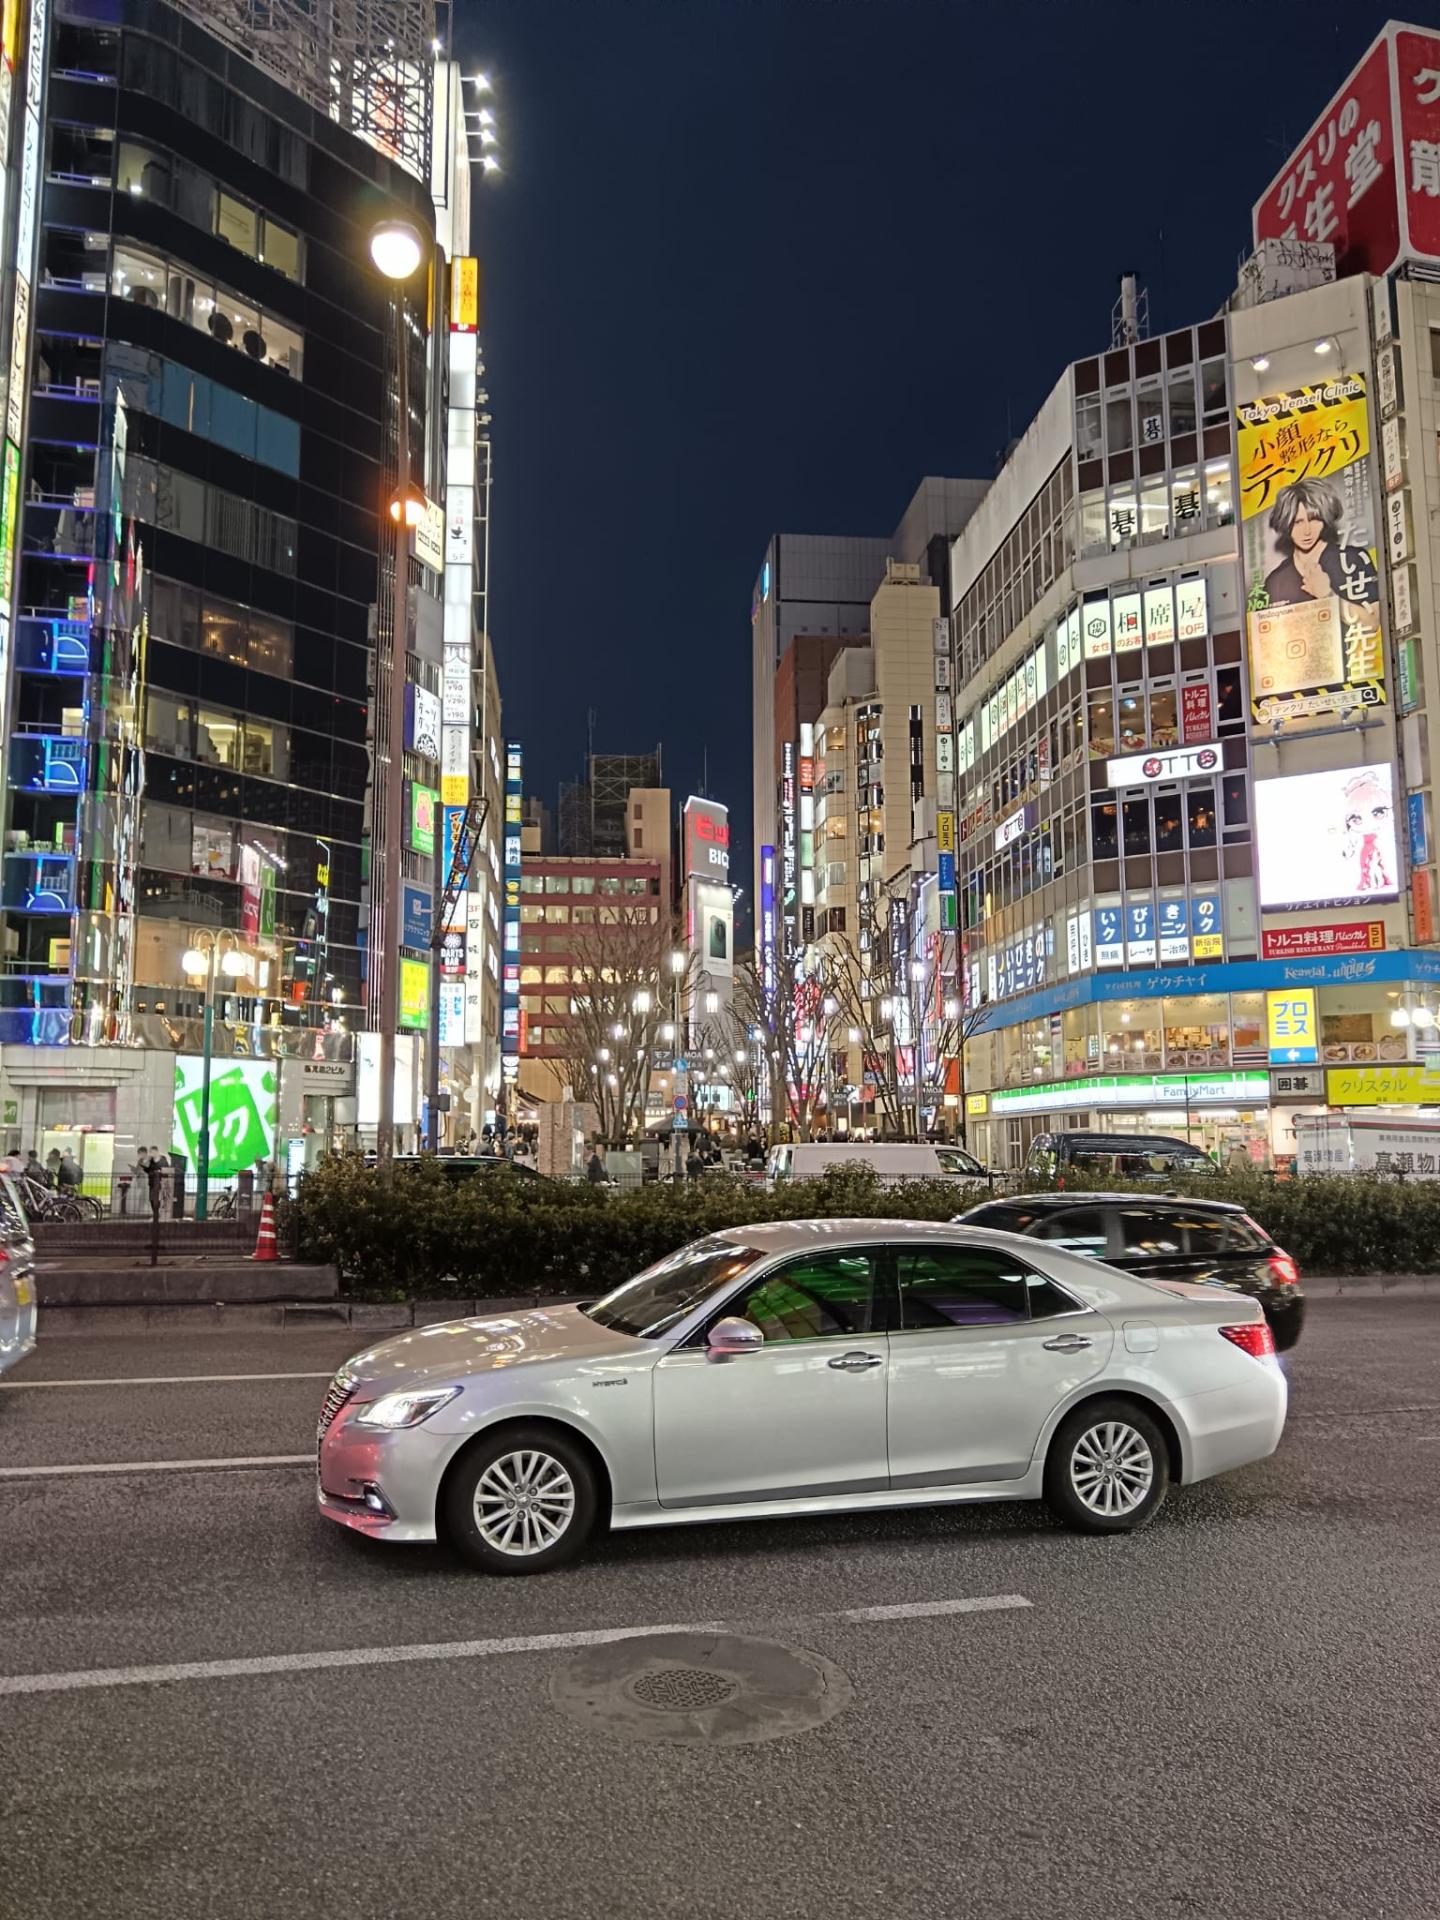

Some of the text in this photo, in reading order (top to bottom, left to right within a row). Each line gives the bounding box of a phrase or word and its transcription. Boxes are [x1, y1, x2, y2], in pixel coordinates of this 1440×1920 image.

[1277, 97, 1360, 220] クスリの
[1280, 119, 1384, 242] 生堂
[1242, 380, 1361, 421] Tokyo Tensei Clinic
[1144, 418, 1161, 440] 碁
[1173, 489, 1200, 519] 碁
[1111, 508, 1136, 535] 碁
[1117, 596, 1206, 634] 相席屋
[1184, 688, 1208, 700] トルコ
[942, 816, 950, 847] プロミス
[1266, 929, 1335, 948] トルコ料理
[441, 947, 464, 959] DARTS
[444, 957, 460, 967] BAR
[1146, 973, 1208, 990] ゲウチャイ
[1273, 1001, 1308, 1018] プロ
[1274, 1019, 1309, 1036] ミス
[1162, 1084, 1226, 1098] FamilyMart
[1278, 1077, 1309, 1091] 囲碁
[1340, 1080, 1408, 1093] クリスタル
[1375, 1150, 1440, 1174] 高瀬物
